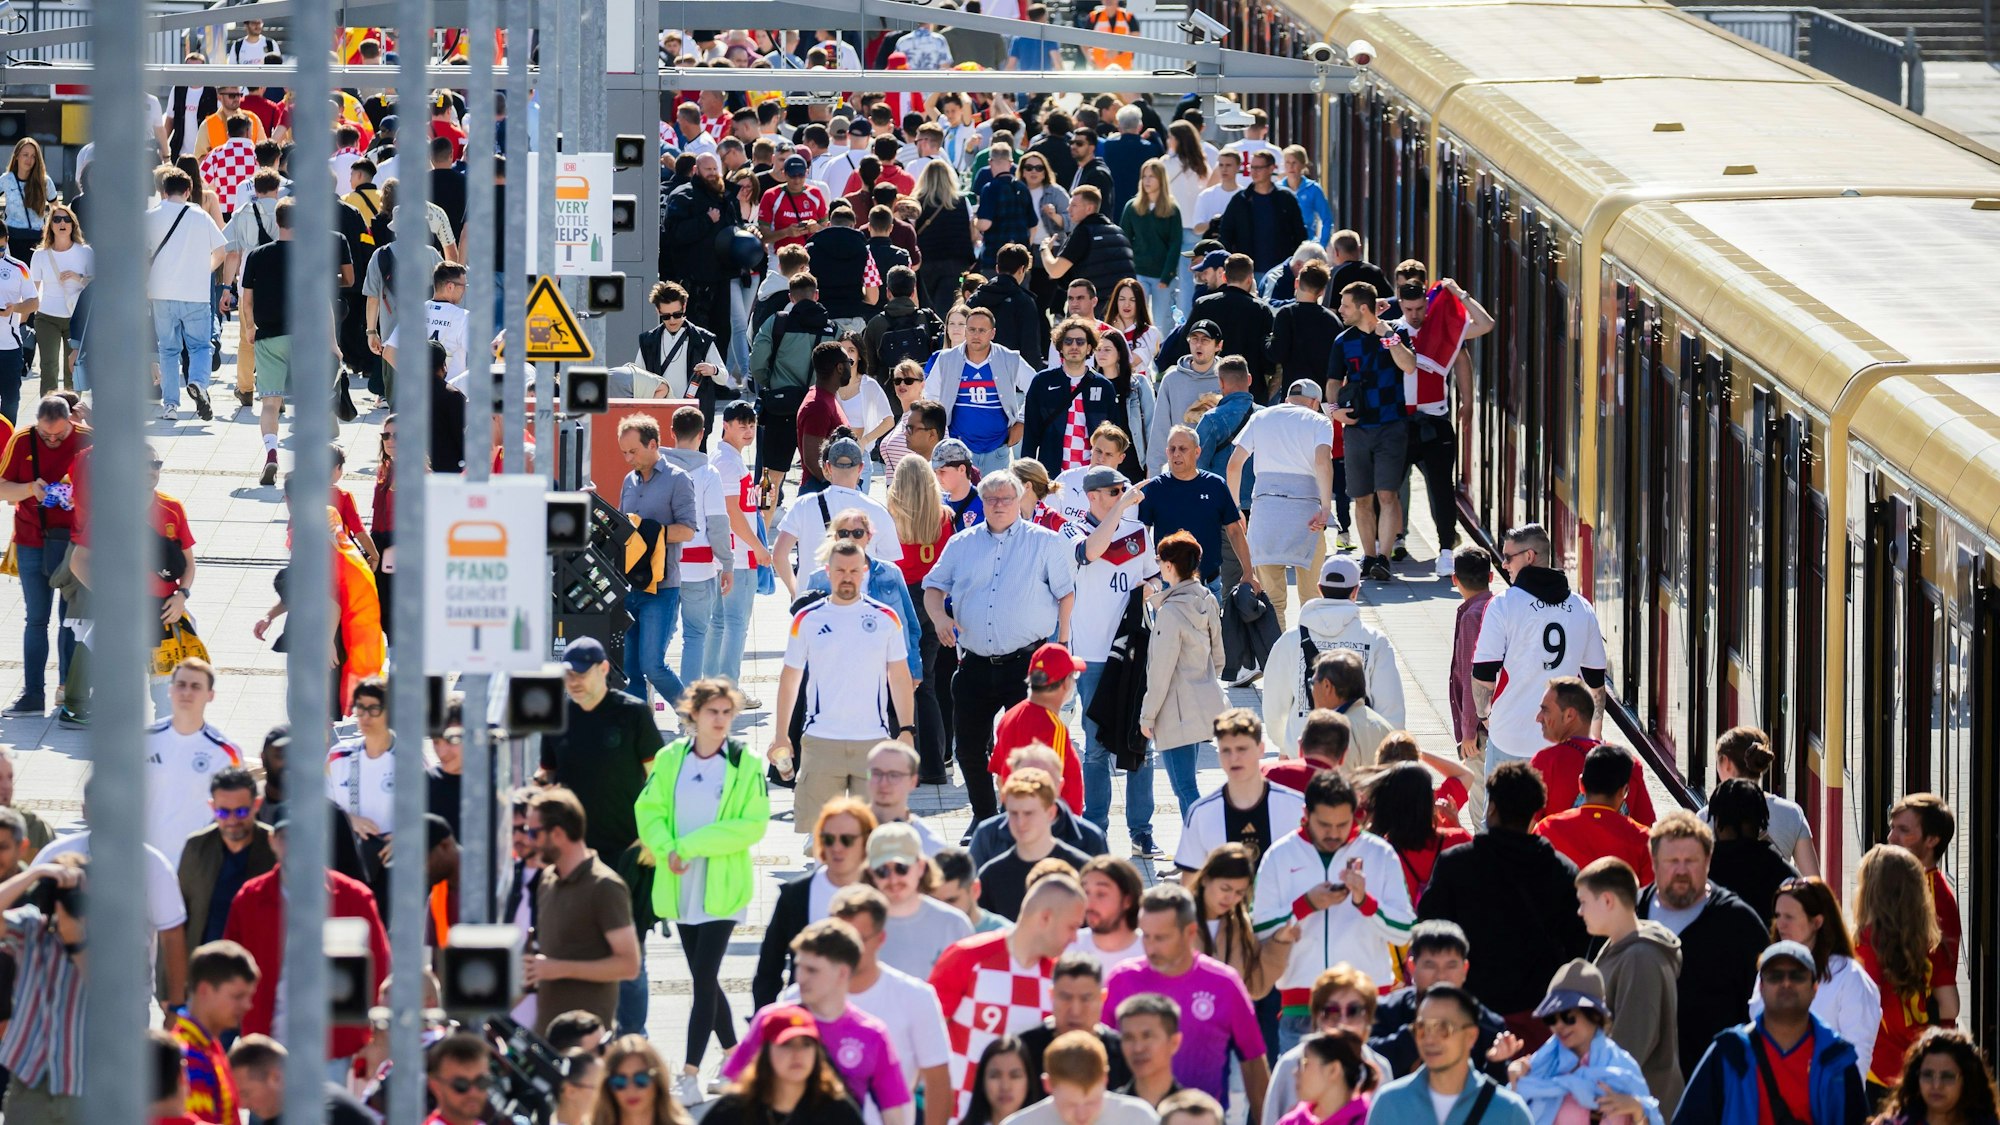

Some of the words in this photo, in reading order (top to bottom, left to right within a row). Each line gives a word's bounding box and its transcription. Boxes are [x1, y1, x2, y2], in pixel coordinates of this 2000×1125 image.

[564, 163, 576, 171] DB
[557, 202, 588, 213] VERY
[557, 216, 588, 226] OTTLE
[556, 228, 588, 241] ELPS
[969, 387, 987, 403] 10
[1065, 507, 1088, 519] CHE
[446, 562, 508, 581] PFAND
[1110, 572, 1128, 593] 40
[446, 606, 508, 620] DANEBEN
[1543, 622, 1566, 670] 9
[981, 1005, 1003, 1034] 9
